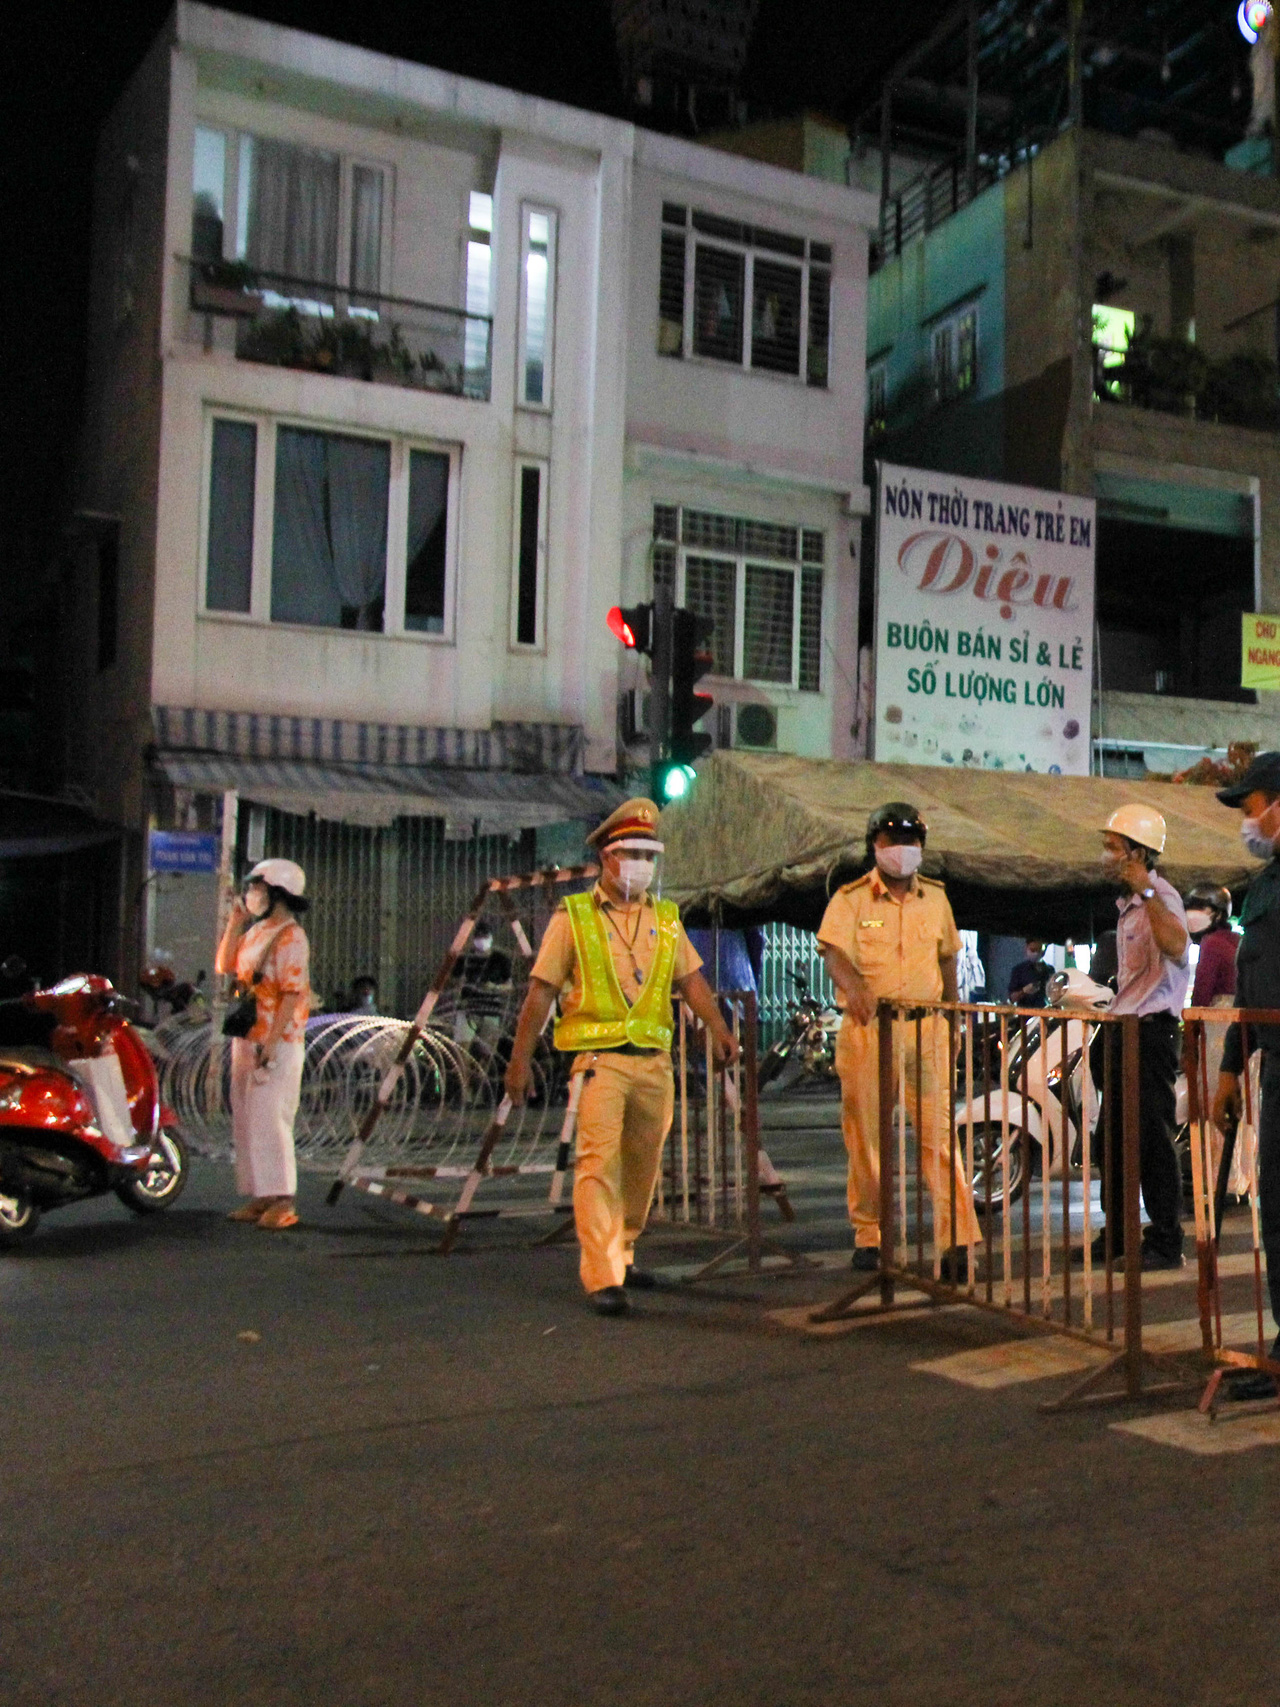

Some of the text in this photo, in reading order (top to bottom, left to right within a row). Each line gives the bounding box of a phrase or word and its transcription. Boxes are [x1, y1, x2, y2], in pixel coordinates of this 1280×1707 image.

[885, 479, 1091, 548] NÓN THỜI TRANG TRẺ EM
[897, 530, 1079, 621] Diệu
[886, 618, 1084, 671] BUÔN BÁN SỈ & LẺ
[1255, 621, 1276, 641] CHO
[906, 659, 1066, 709] SỐ LƯỢNG LỚN
